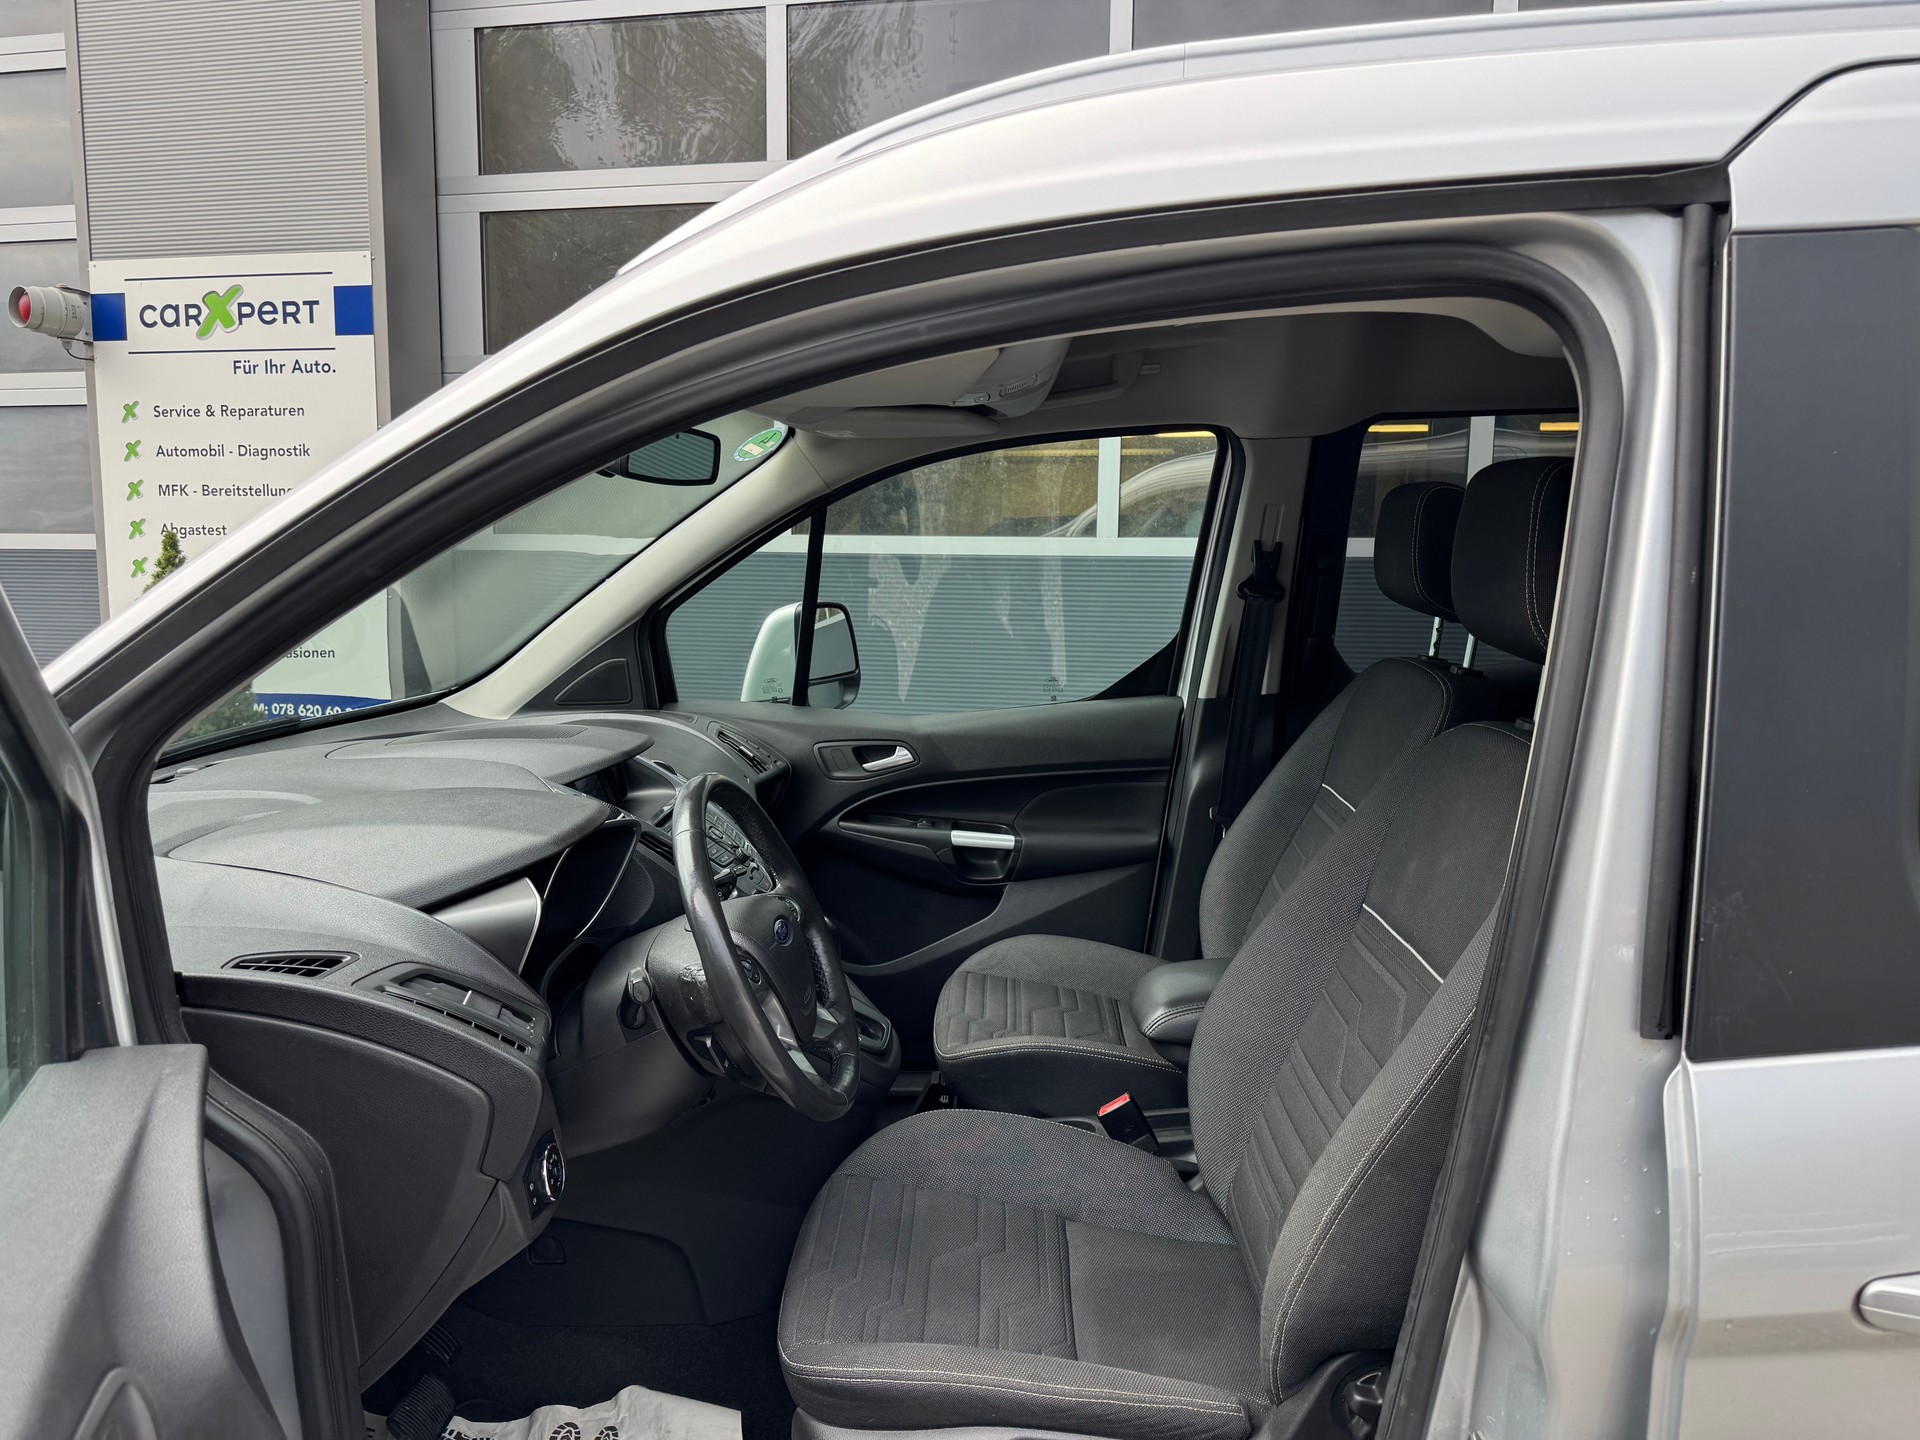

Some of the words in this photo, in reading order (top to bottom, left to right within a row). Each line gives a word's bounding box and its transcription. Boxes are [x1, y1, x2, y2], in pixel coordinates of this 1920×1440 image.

[233, 359, 259, 375] Für
[264, 359, 286, 375] Ihr
[291, 359, 337, 374] Auto.
[153, 404, 201, 418] Service
[205, 404, 216, 418] &
[220, 404, 305, 420] Reparaturen
[155, 443, 225, 458] Automobil
[237, 443, 311, 461] Diagnostik
[158, 483, 190, 497] MFK
[253, 702, 269, 715] M:
[271, 703, 295, 716] 078
[298, 704, 323, 718] 620
